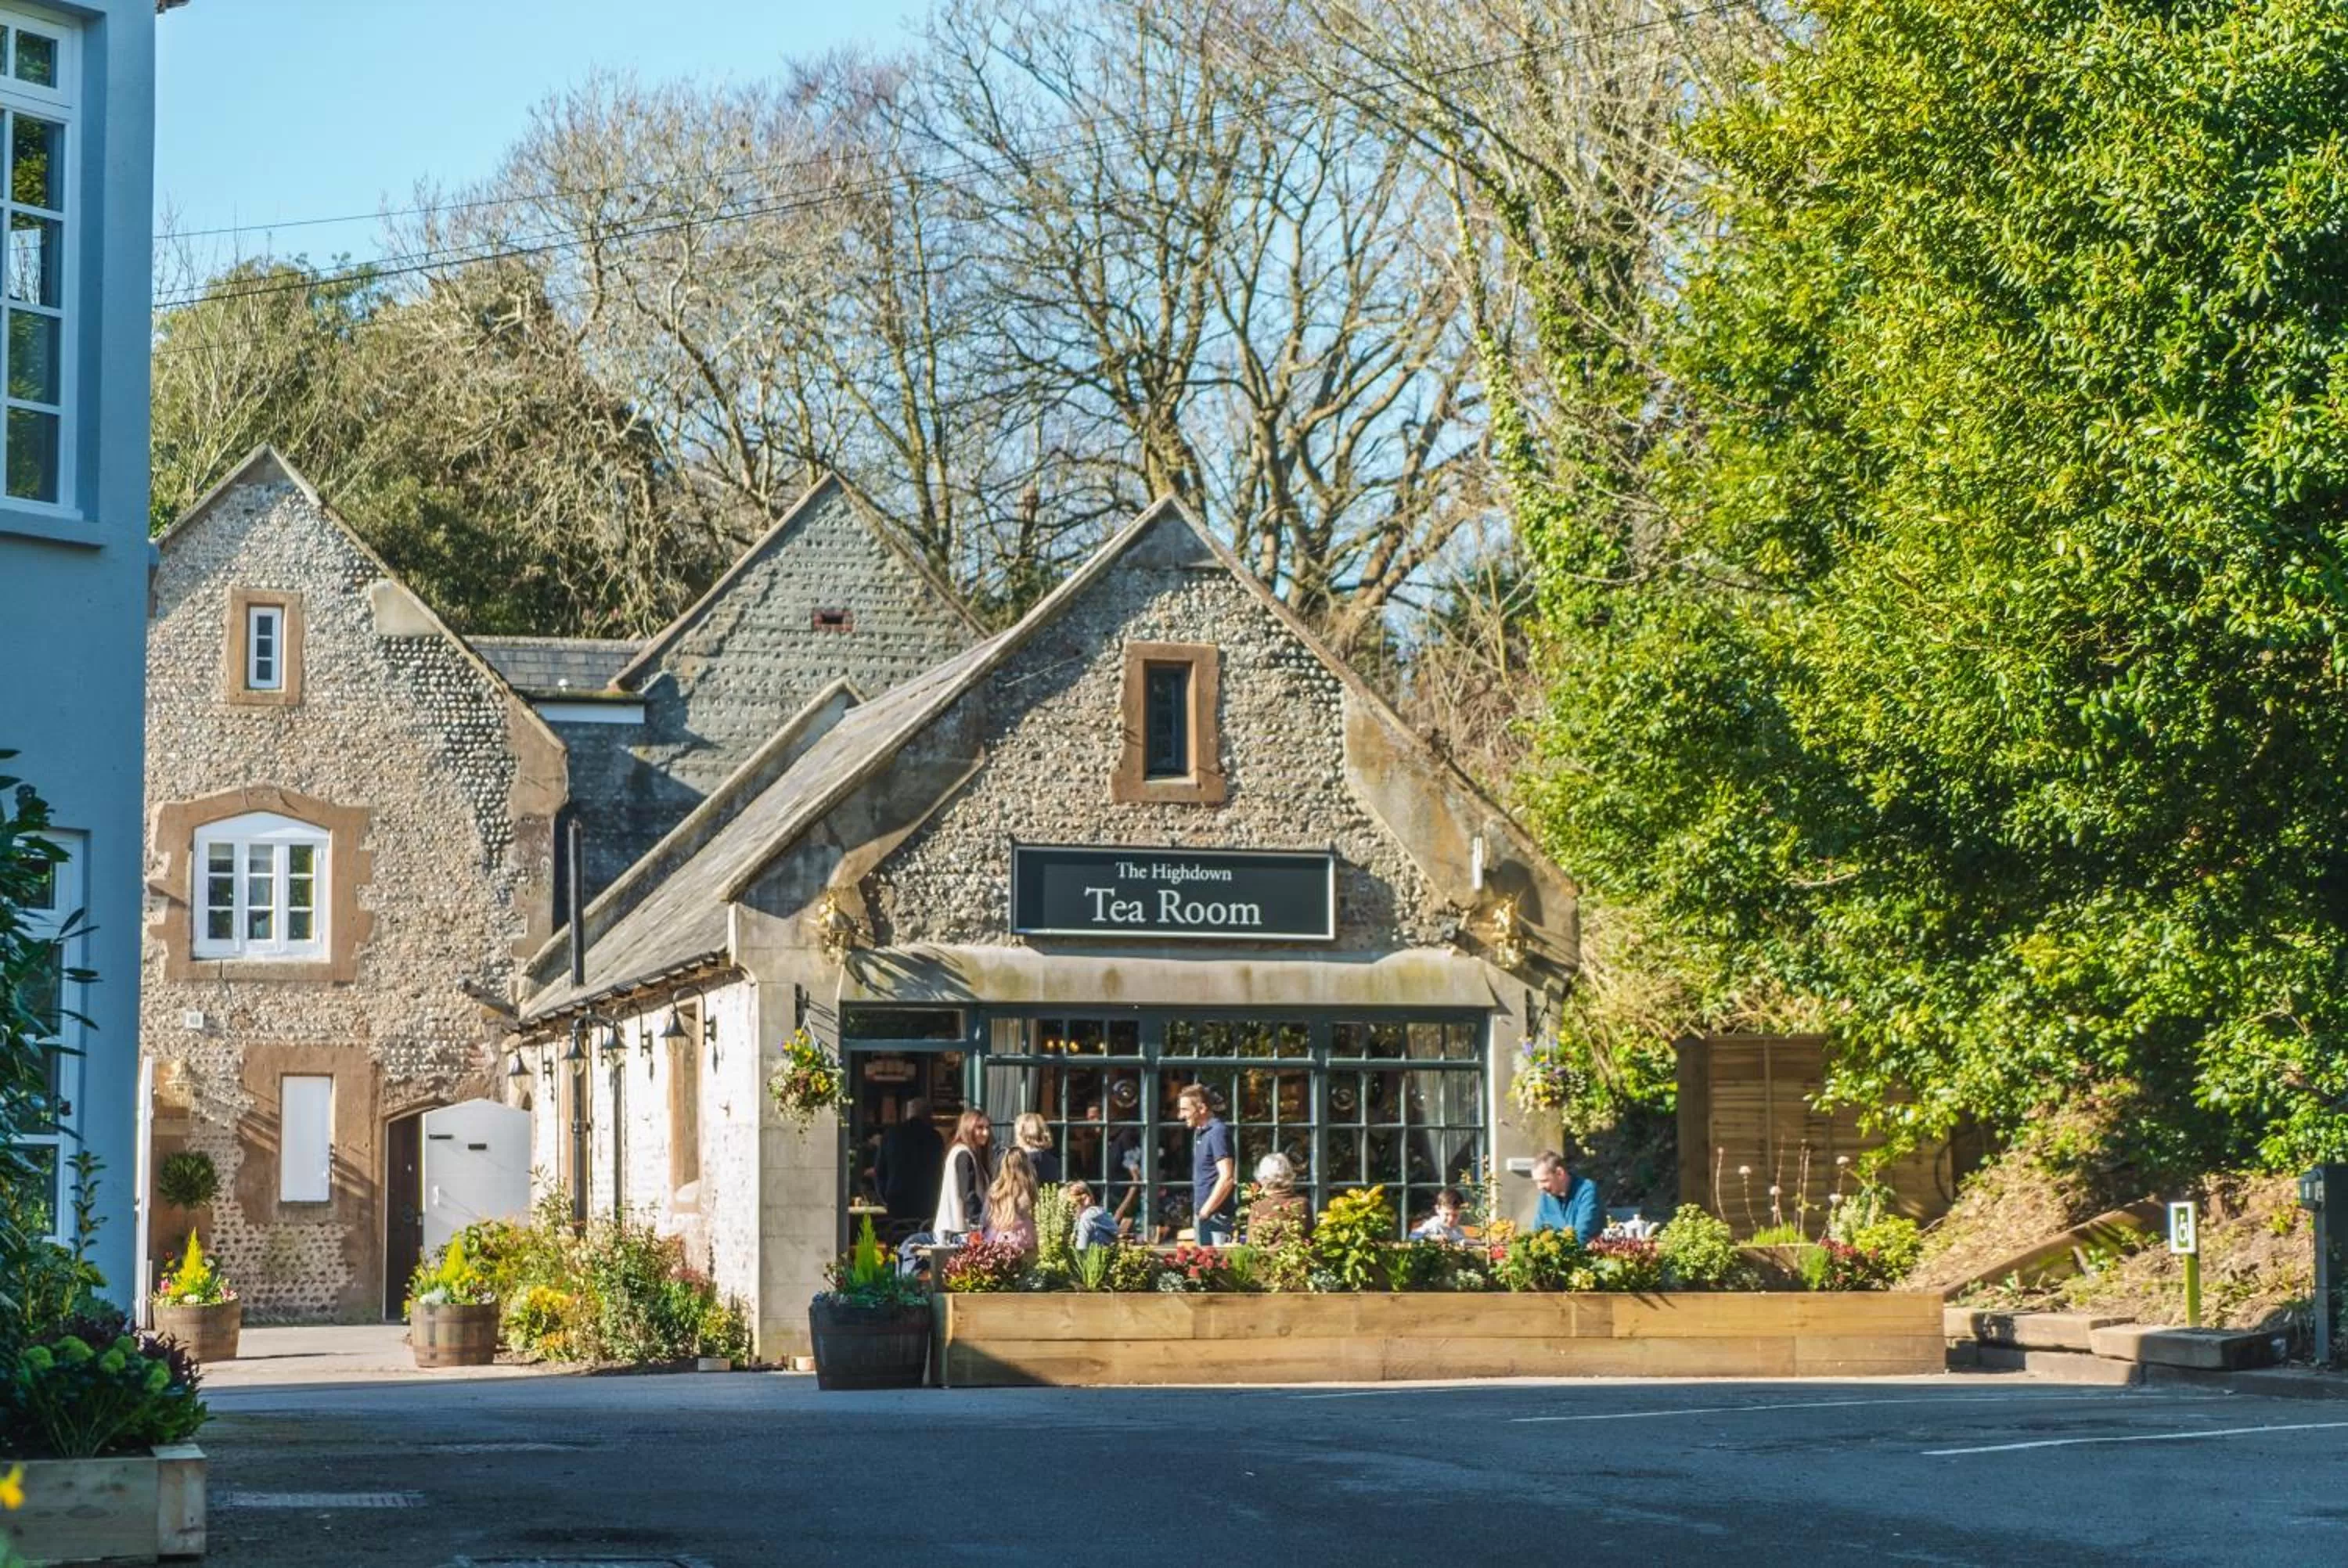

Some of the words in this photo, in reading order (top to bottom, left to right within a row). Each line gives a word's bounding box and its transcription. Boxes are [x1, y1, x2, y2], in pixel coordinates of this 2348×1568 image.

[1115, 861, 1147, 879] The
[1151, 863, 1233, 884] Highdown
[1085, 886, 1147, 922] Tea
[1157, 889, 1262, 926] Room
